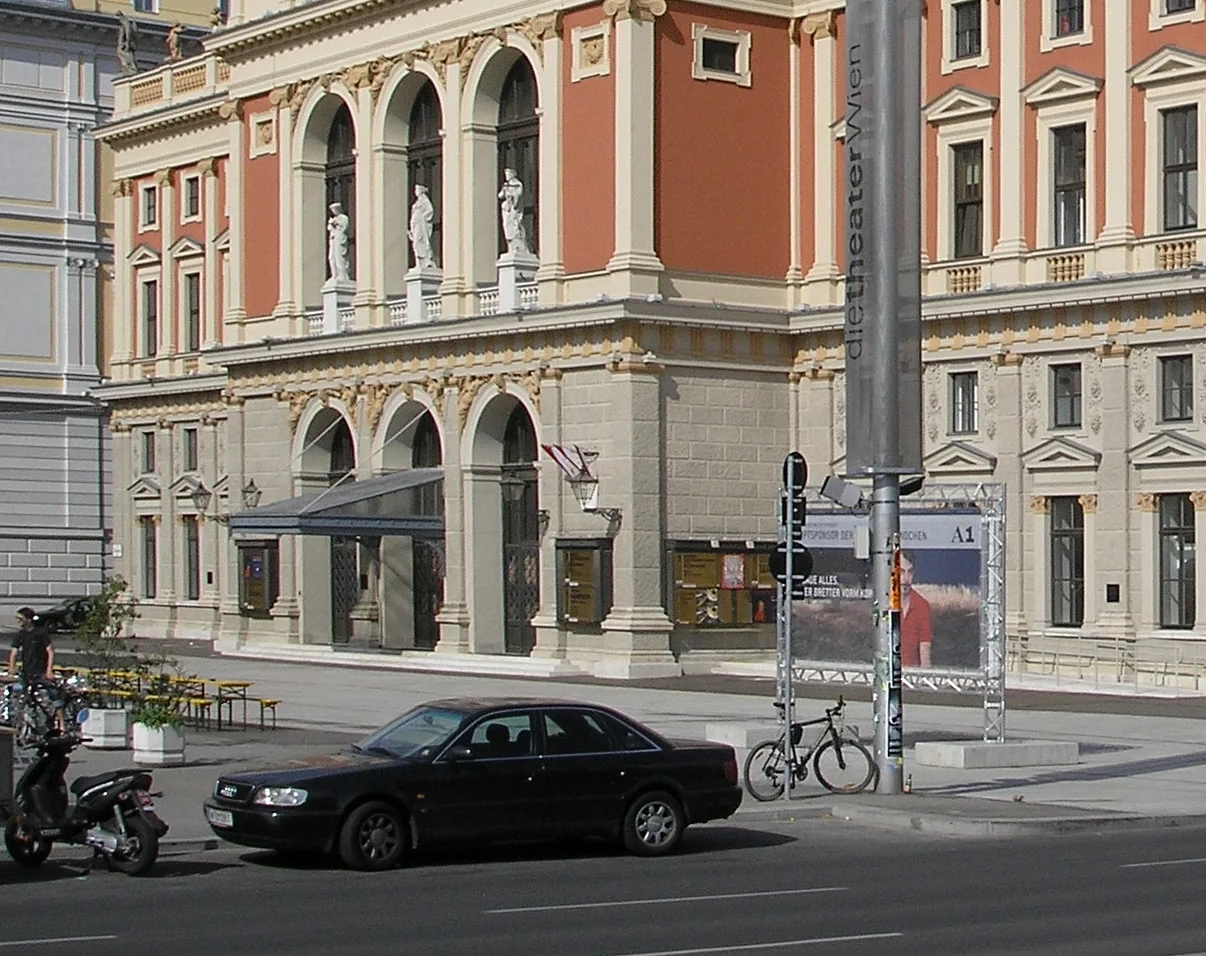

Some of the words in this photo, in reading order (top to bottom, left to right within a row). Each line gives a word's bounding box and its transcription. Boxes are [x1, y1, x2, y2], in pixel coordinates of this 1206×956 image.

[951, 525, 975, 543] A1
[818, 574, 840, 586] ALLES.
[813, 586, 840, 598] BRETTER
[841, 587, 860, 599] VORM
[860, 588, 874, 599] KOP
